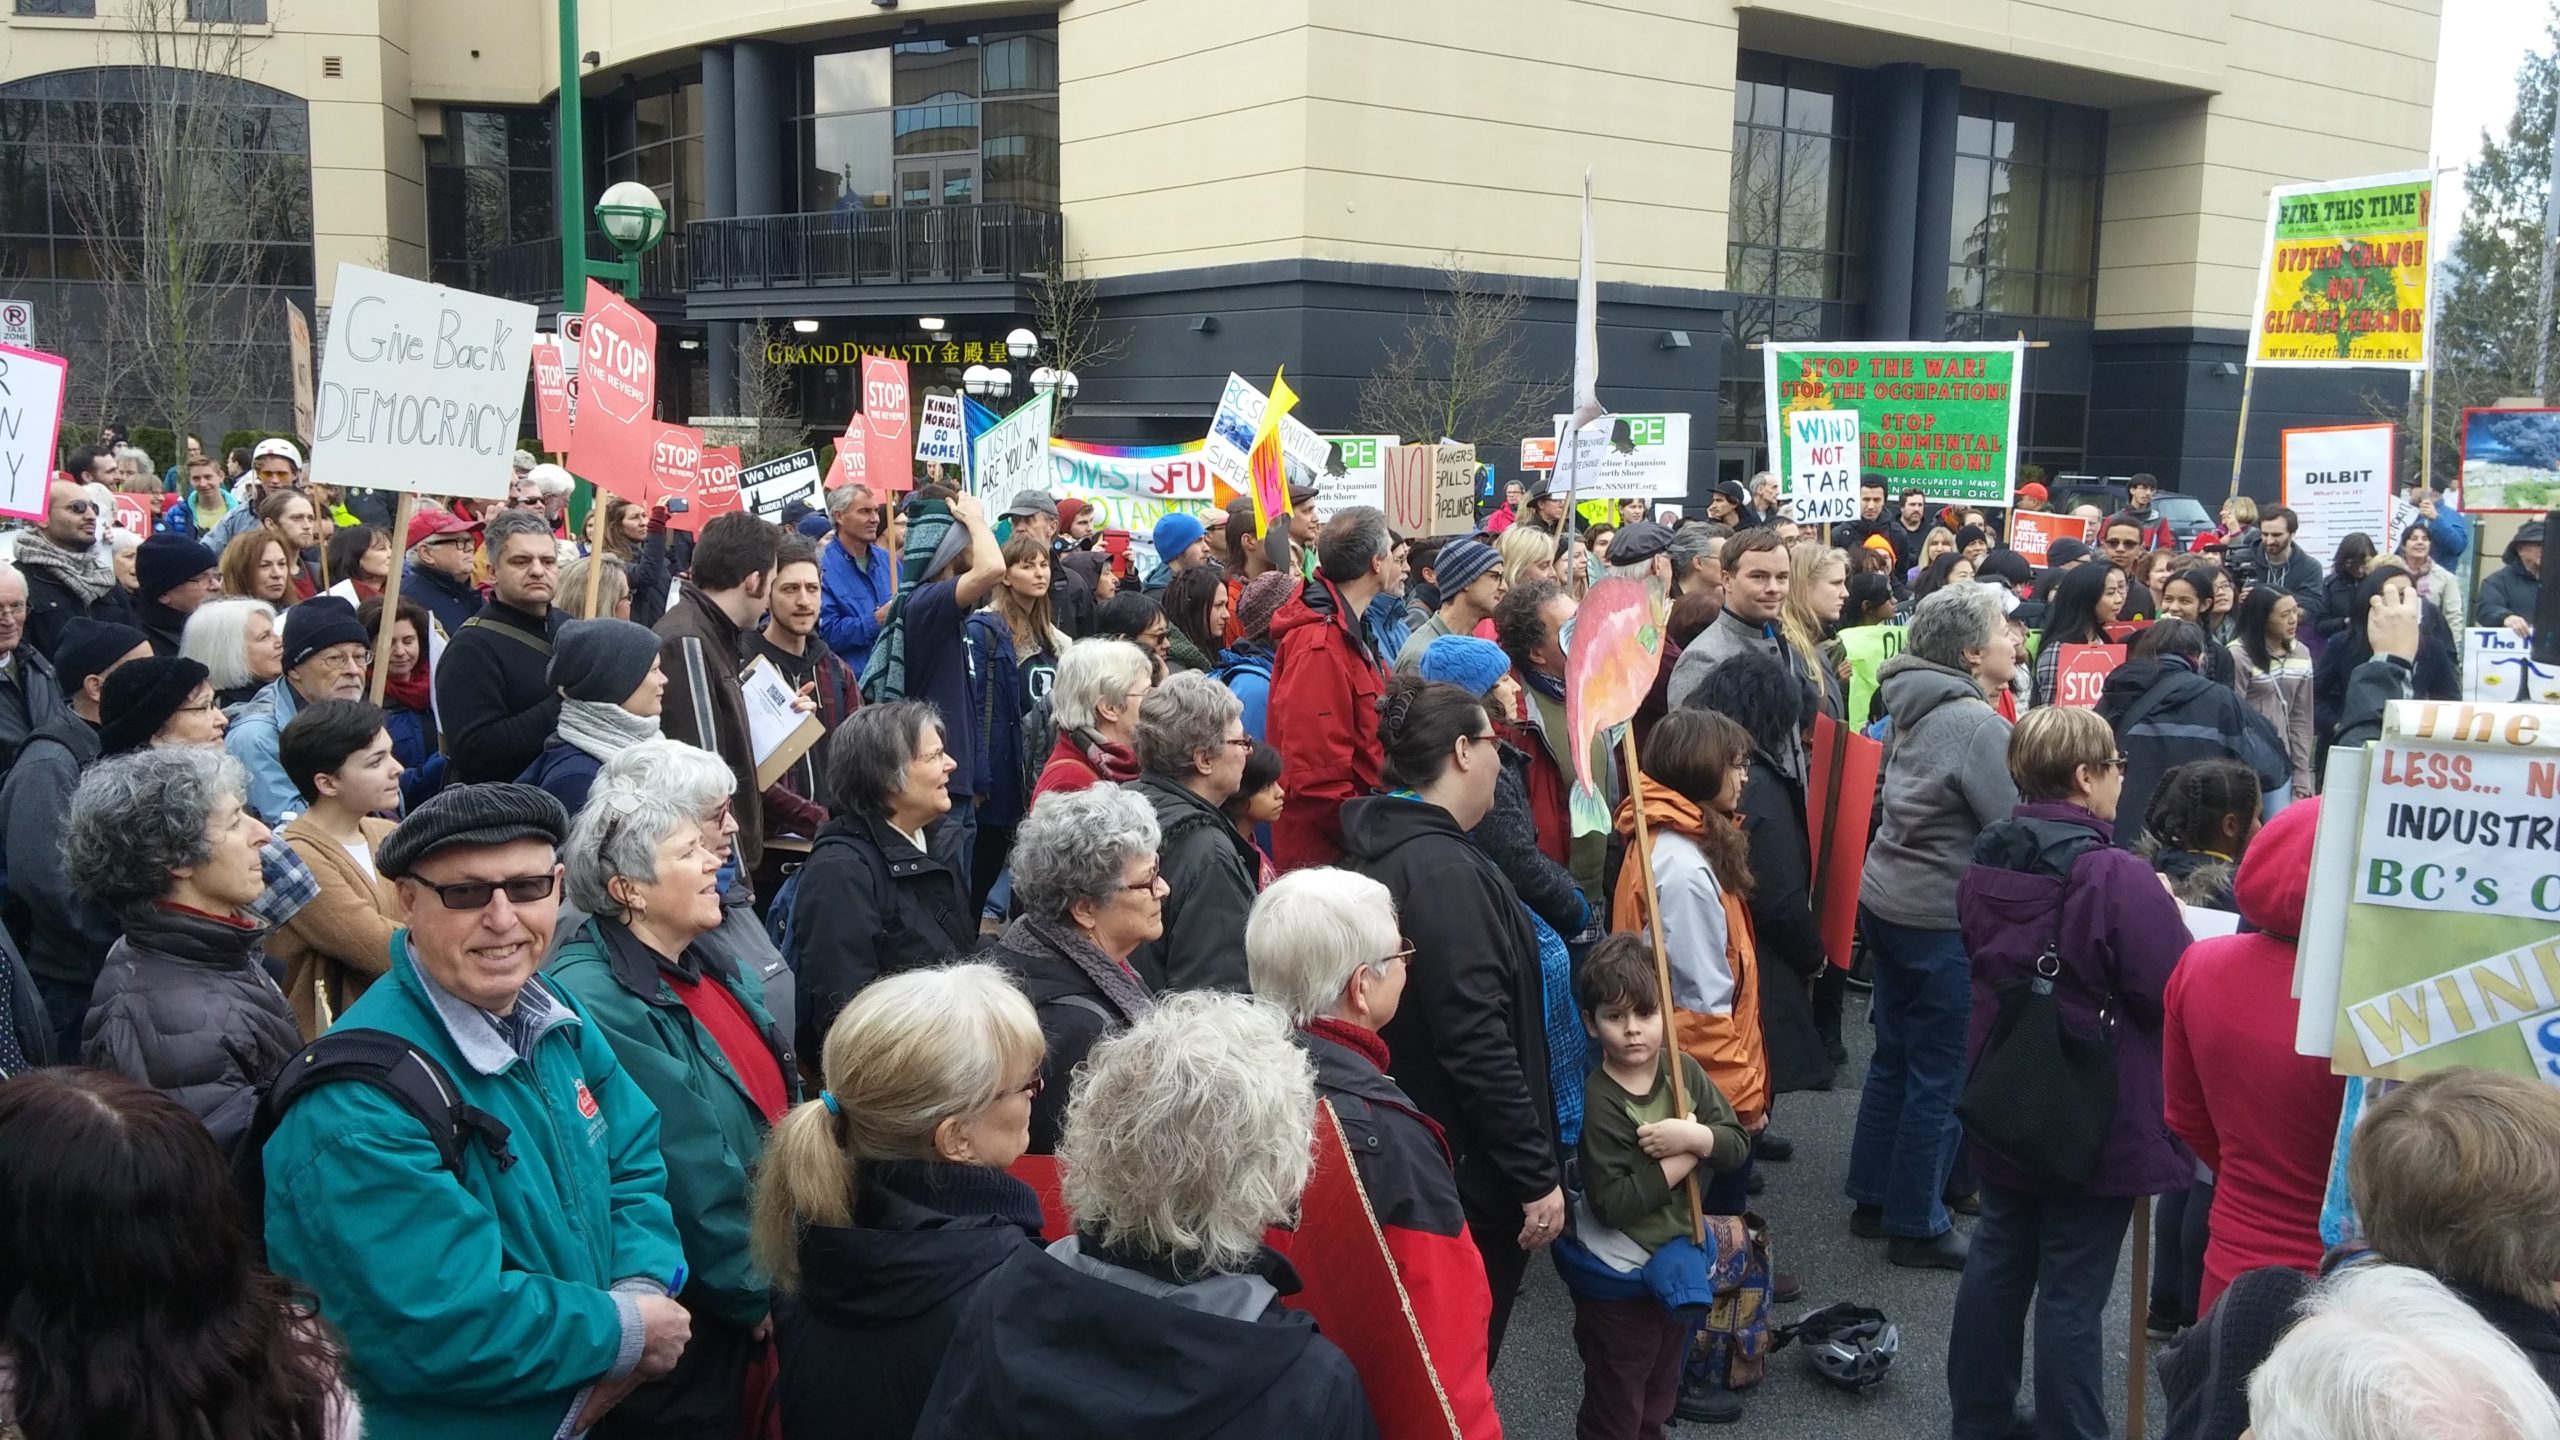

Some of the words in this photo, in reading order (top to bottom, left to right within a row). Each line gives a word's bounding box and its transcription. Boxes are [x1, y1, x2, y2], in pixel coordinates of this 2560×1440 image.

[2278, 202, 2319, 225] FIRE
[2324, 199, 2365, 222] THIS
[2368, 193, 2416, 217] TIME
[2278, 245, 2343, 272] SYSTEM
[2349, 240, 2424, 268] CHANGE
[2326, 276, 2367, 301] NOT
[2264, 309, 2340, 334] CLIMATE
[2349, 308, 2423, 333] CHANGE
[345, 296, 423, 363] Give
[433, 309, 512, 371] Back
[589, 322, 647, 383] STOP
[767, 342, 839, 364] GRAND
[539, 364, 561, 387] STOP
[588, 362, 606, 381] THE
[1801, 358, 1859, 377] STOP
[1869, 358, 1914, 378] THE
[1924, 358, 1986, 378] WAR!
[869, 381, 904, 409] STOP
[1781, 380, 1825, 398] STOP
[1832, 382, 1865, 399] THE
[1873, 383, 2007, 400] OCCUPATION!
[927, 399, 958, 414] KINDE
[316, 382, 519, 455] DEMOCRACY
[924, 413, 961, 429] MORGA
[1882, 414, 1936, 431] STOP
[934, 429, 947, 441] GO
[983, 416, 1022, 466] JUSTIN
[1797, 417, 1855, 444] WIND
[920, 442, 960, 458] HOME!
[1859, 432, 2001, 452] IRONMENTAL
[656, 442, 698, 467] STOP
[844, 452, 866, 470] STO
[980, 459, 1000, 498] ARE
[1005, 442, 1022, 478] YOU
[1025, 433, 1039, 462] ON
[1437, 448, 1474, 464] TANKERS
[1624, 459, 1666, 470] Expansion
[1811, 446, 1844, 466] NOT
[744, 470, 765, 485] We
[765, 461, 791, 478] Vote
[792, 456, 808, 470] No
[1149, 460, 1206, 494] SFU
[1436, 468, 1471, 489] SPILLS
[1621, 469, 1645, 477] Shore
[1803, 470, 1849, 492] TAR
[2305, 470, 2373, 484] DILBIT
[1336, 481, 1377, 491] Expansion
[1388, 447, 1423, 530] NO
[1910, 478, 1963, 486] OCCUPATION
[757, 500, 782, 514] KINDER
[1436, 494, 1474, 520] PIPELINES
[1796, 497, 1855, 521] SANDS
[2014, 541, 2047, 555] CLIMATE
[2474, 631, 2515, 649] The
[2065, 671, 2104, 700] STO
[2415, 703, 2540, 746] The
[2381, 749, 2501, 794] LESS...
[2526, 761, 2560, 799] N
[2367, 858, 2499, 906] BC's
